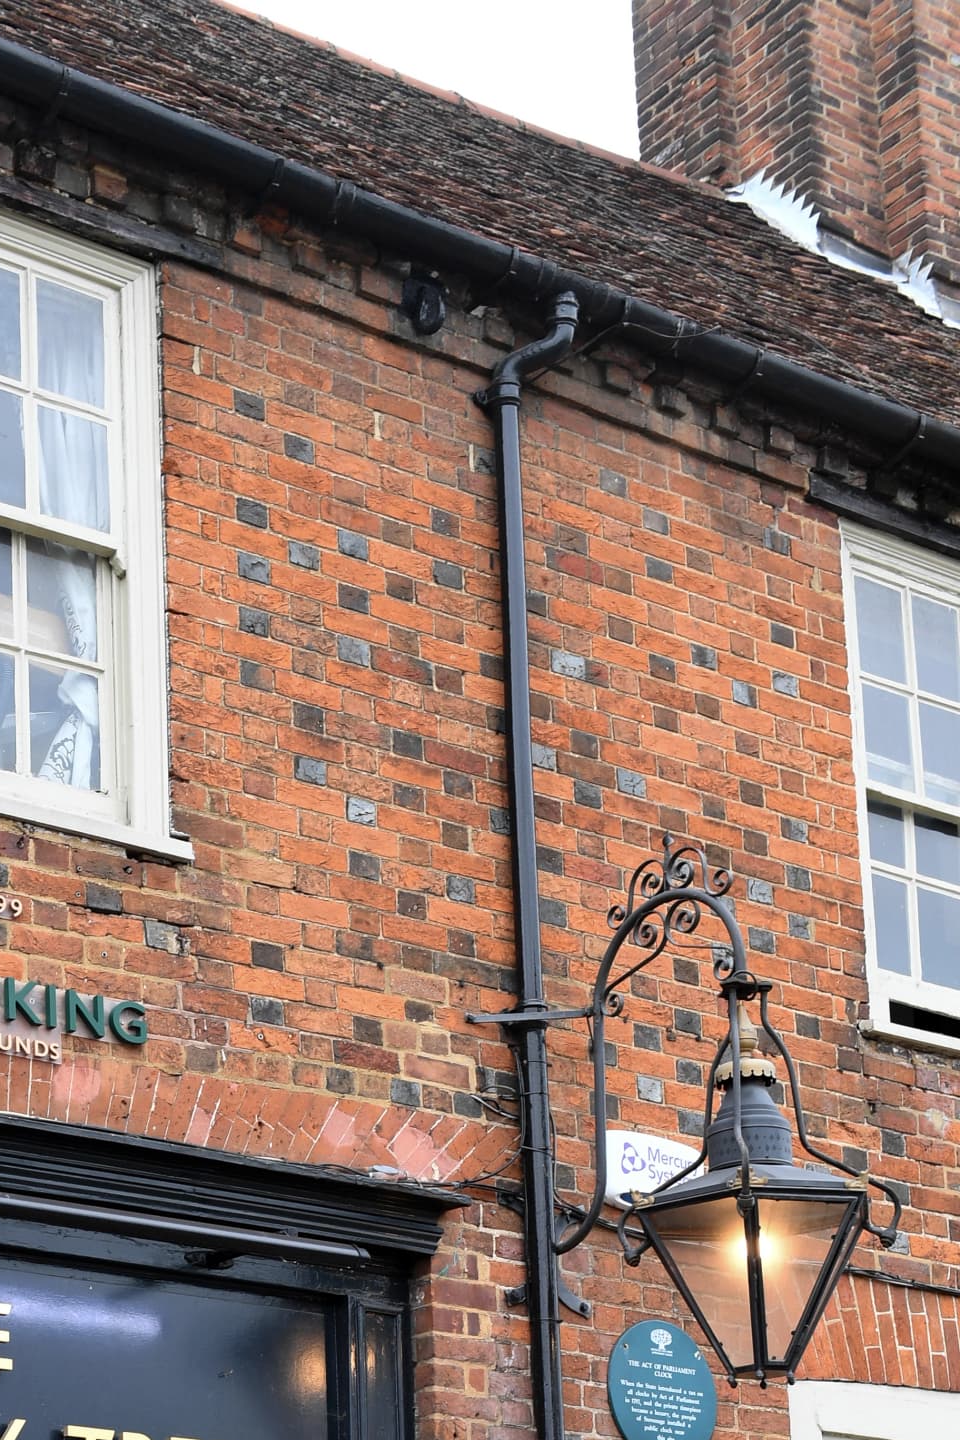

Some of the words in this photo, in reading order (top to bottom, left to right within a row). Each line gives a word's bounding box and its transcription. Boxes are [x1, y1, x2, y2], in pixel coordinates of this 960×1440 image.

[4, 977, 148, 1045] KING
[654, 1371, 673, 1379] CLOCK
[663, 1365, 696, 1375] PARLIAMENT
